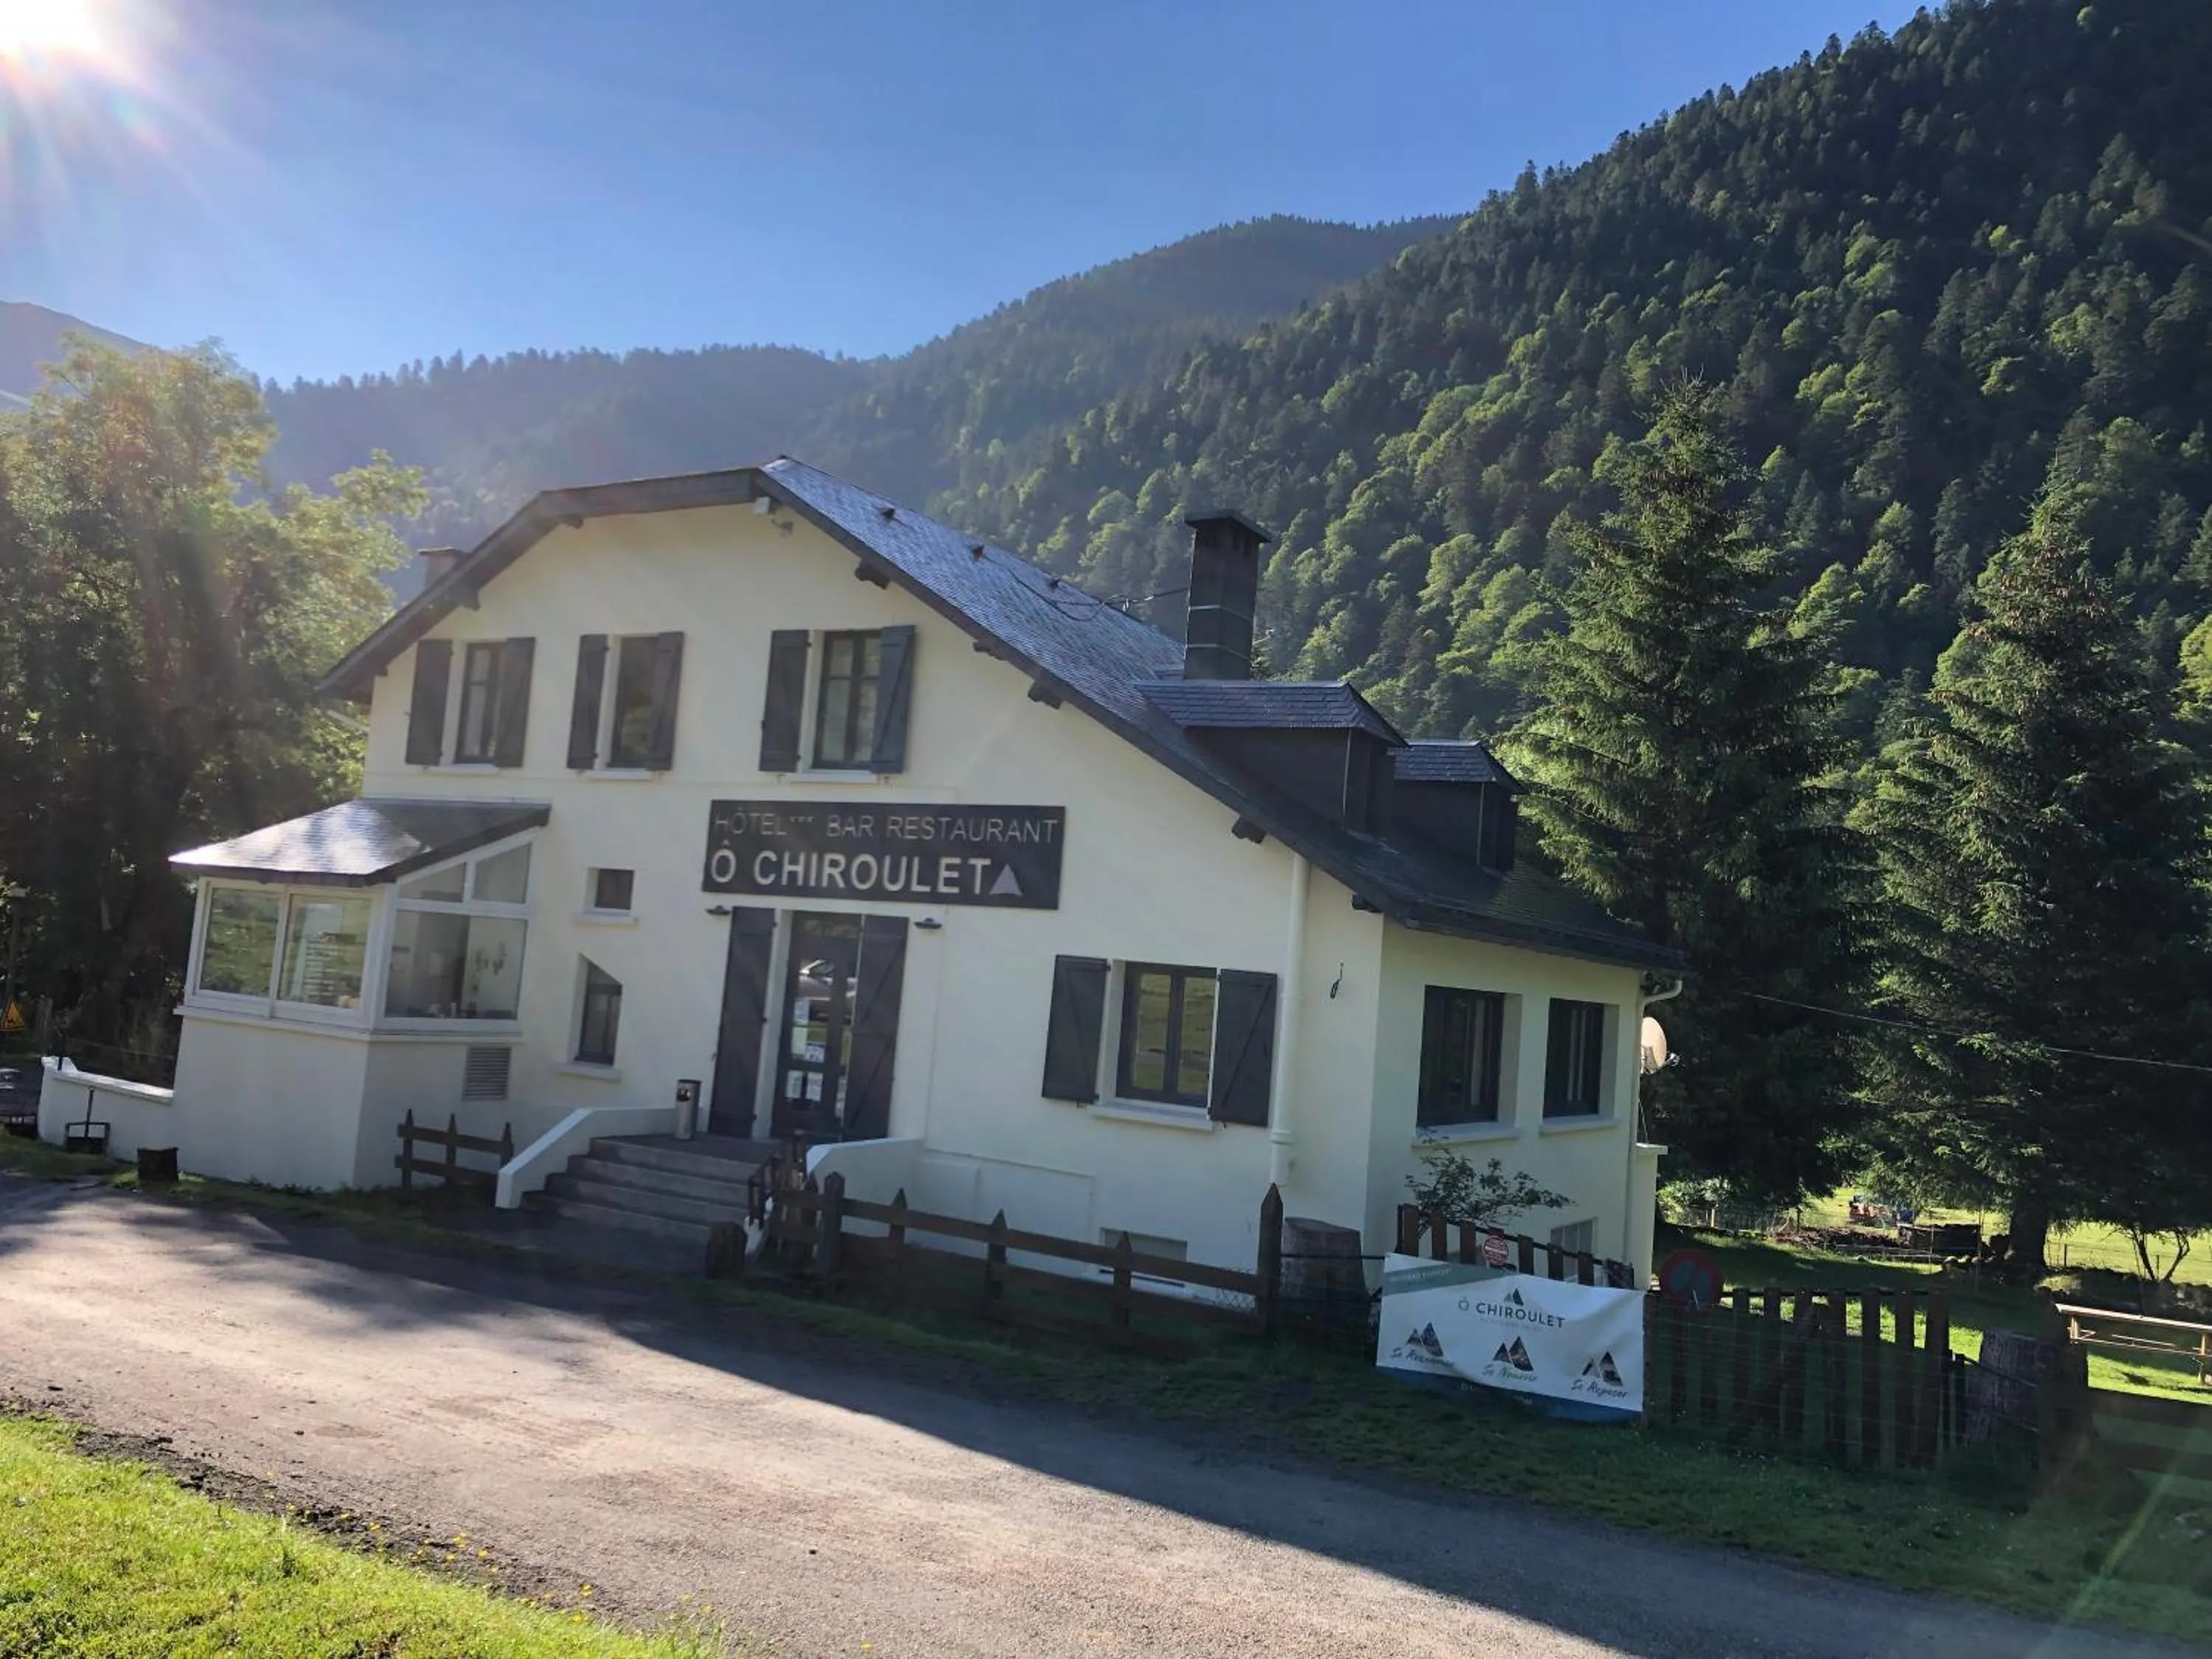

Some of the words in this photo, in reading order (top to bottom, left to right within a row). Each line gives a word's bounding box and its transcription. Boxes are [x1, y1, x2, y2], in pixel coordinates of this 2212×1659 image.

[826, 815, 873, 838] BAR
[886, 815, 1057, 844] RESTAURANT
[711, 839, 736, 883] Ô
[754, 849, 991, 896] CHIROULET
[1476, 1301, 1566, 1329] CHIROULET
